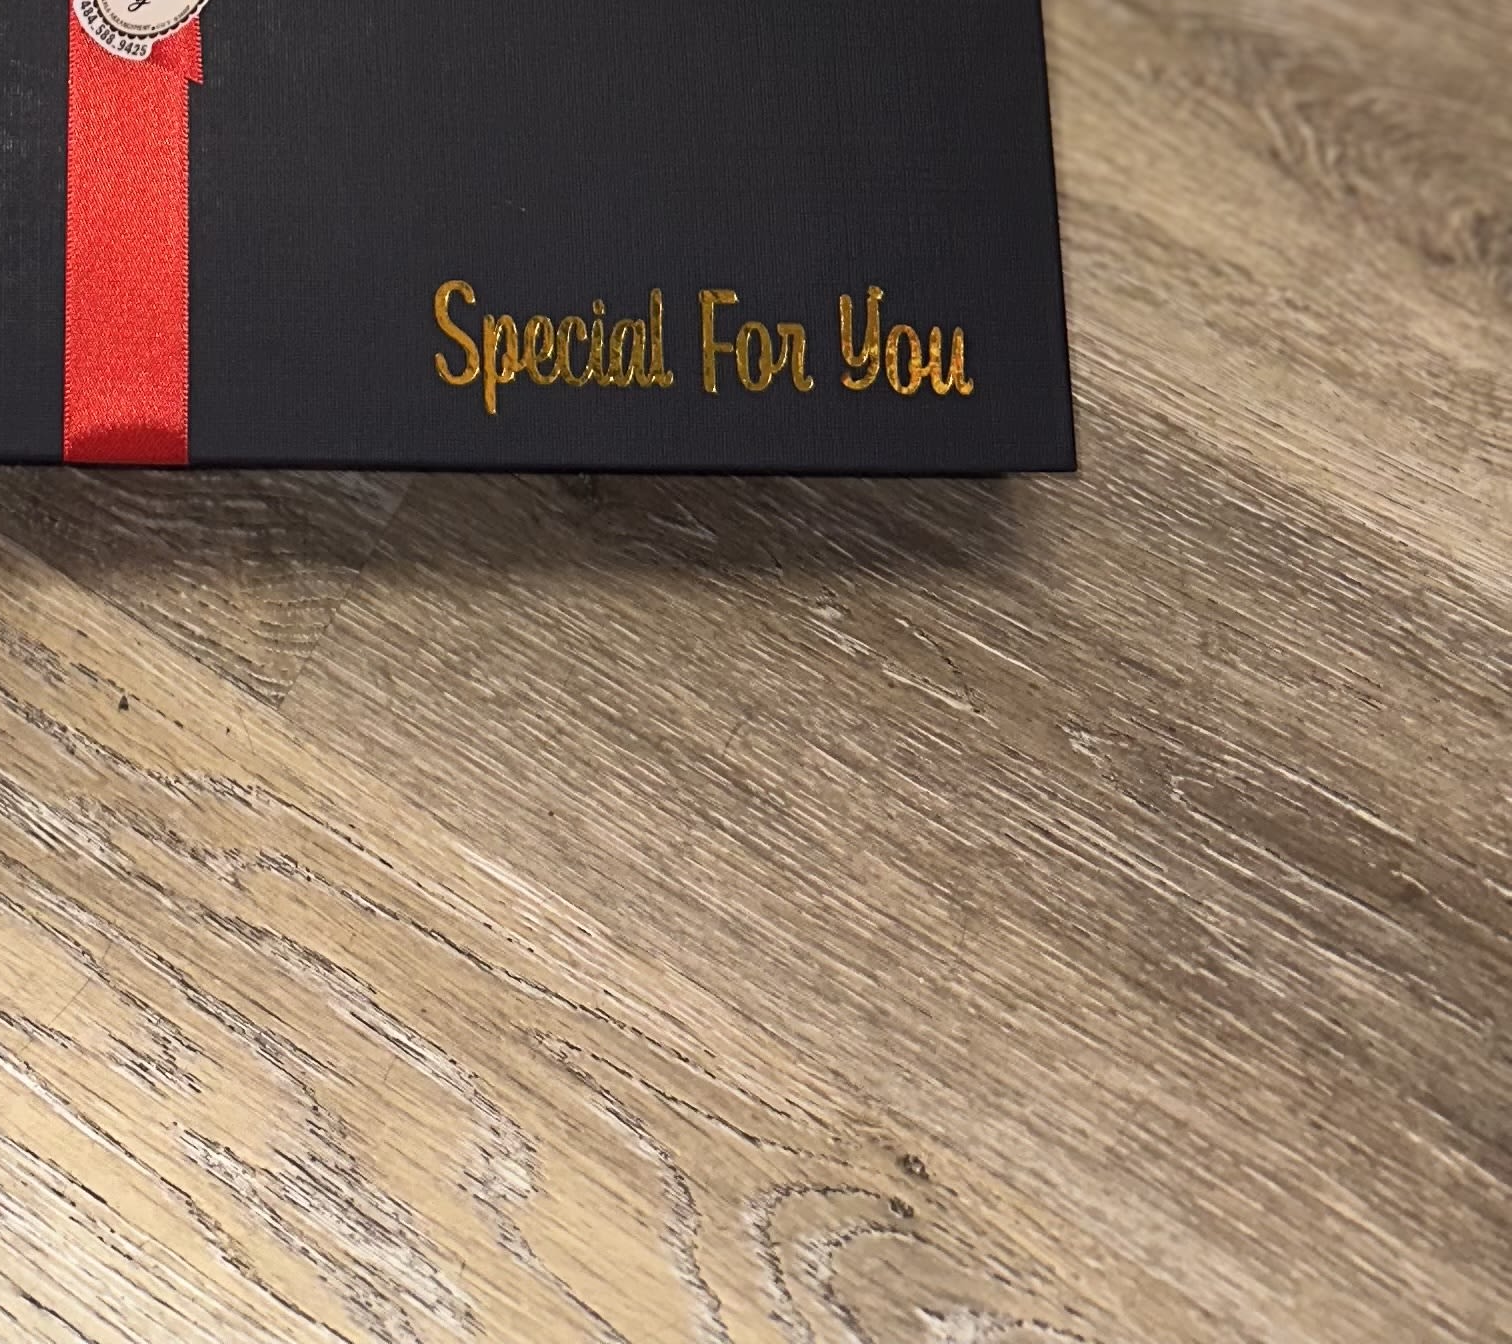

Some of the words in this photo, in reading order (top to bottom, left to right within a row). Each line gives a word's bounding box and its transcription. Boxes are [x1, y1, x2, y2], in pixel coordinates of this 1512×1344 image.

[433, 279, 674, 415] Special
[698, 288, 814, 394] For
[839, 285, 975, 396] You
